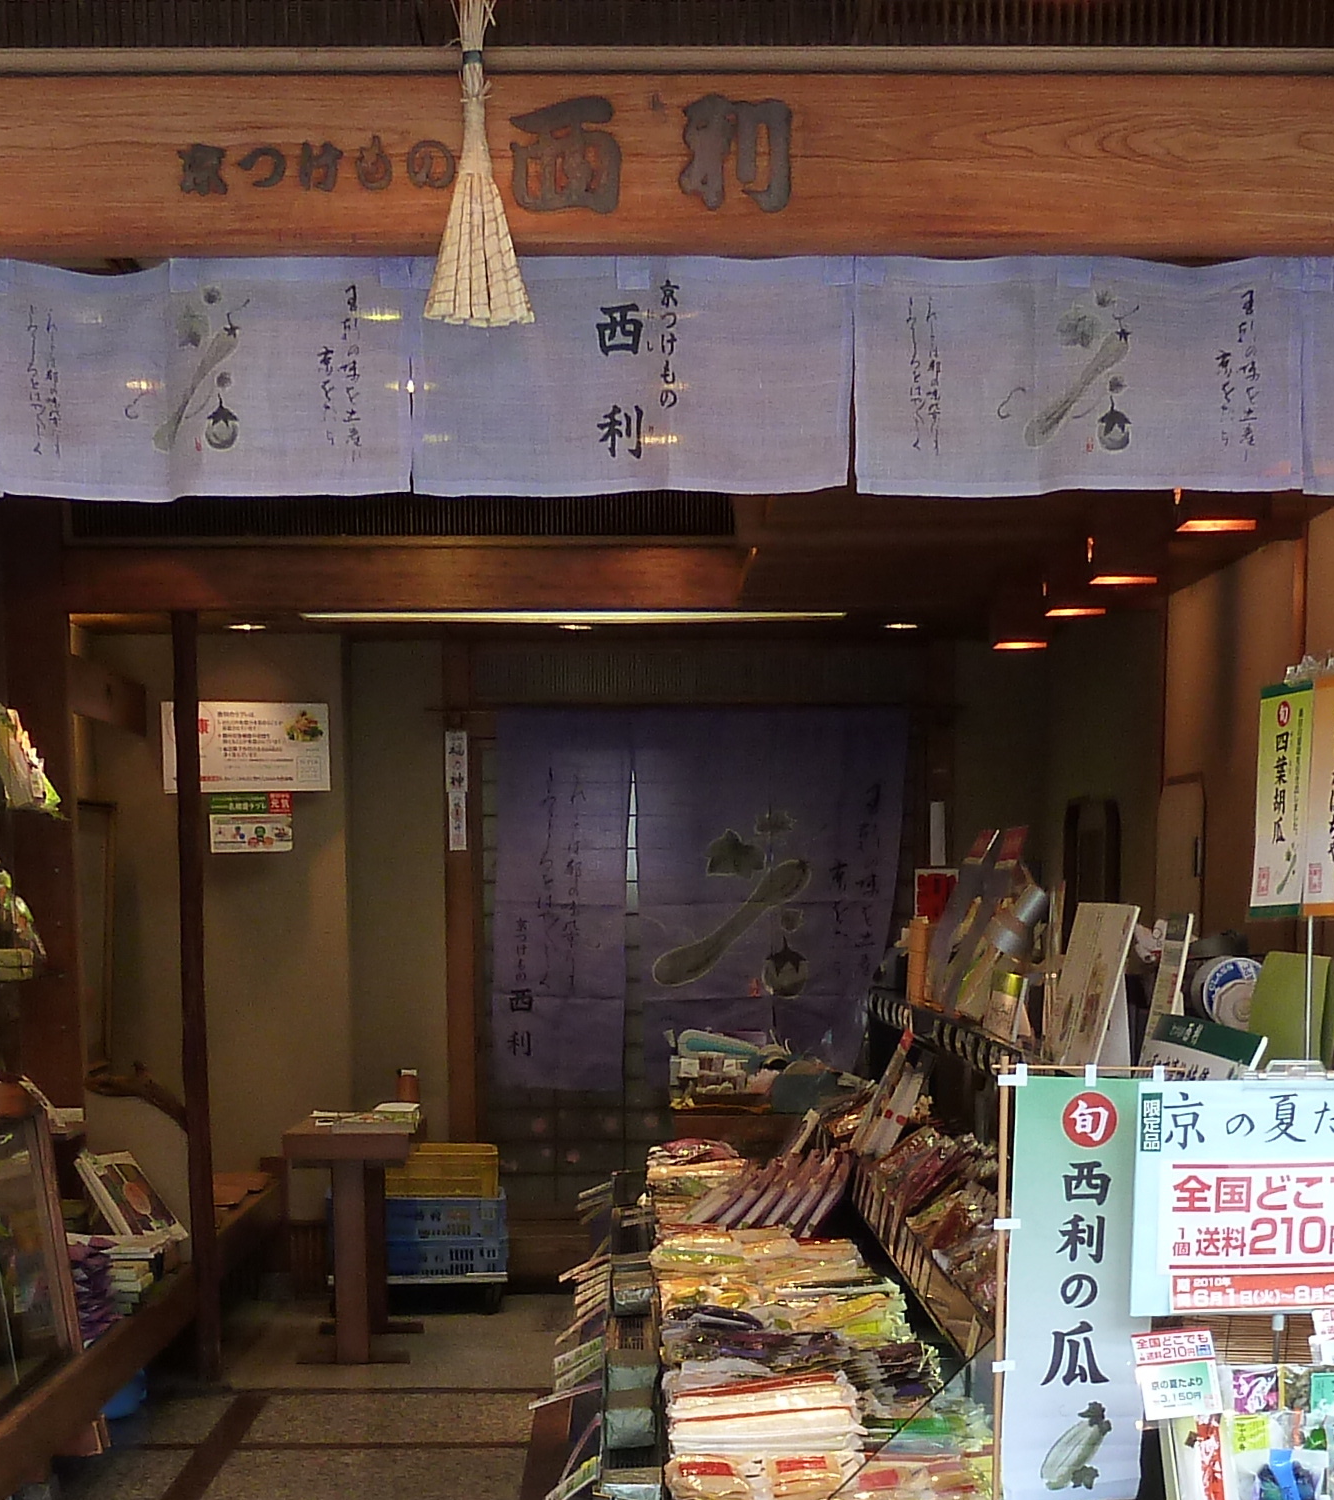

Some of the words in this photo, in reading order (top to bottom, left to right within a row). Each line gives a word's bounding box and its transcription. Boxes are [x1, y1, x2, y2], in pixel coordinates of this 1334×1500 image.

[177, 135, 457, 196] 京つけもの
[509, 95, 793, 214] 西利
[660, 279, 680, 409] 京つけもの
[595, 303, 644, 460] 西利
[1272, 731, 1290, 846] 四葉胡瓜
[508, 989, 534, 1057] 西利
[1069, 1100, 1110, 1141] 旬
[1143, 1101, 1162, 1151] 限定品
[1040, 1161, 1113, 1389] 西利の瓜
[1193, 1276, 1232, 1288] 2010年
[1136, 1332, 1210, 1348] 全国どこでも
[1151, 1376, 1205, 1390] 京の夏たより
